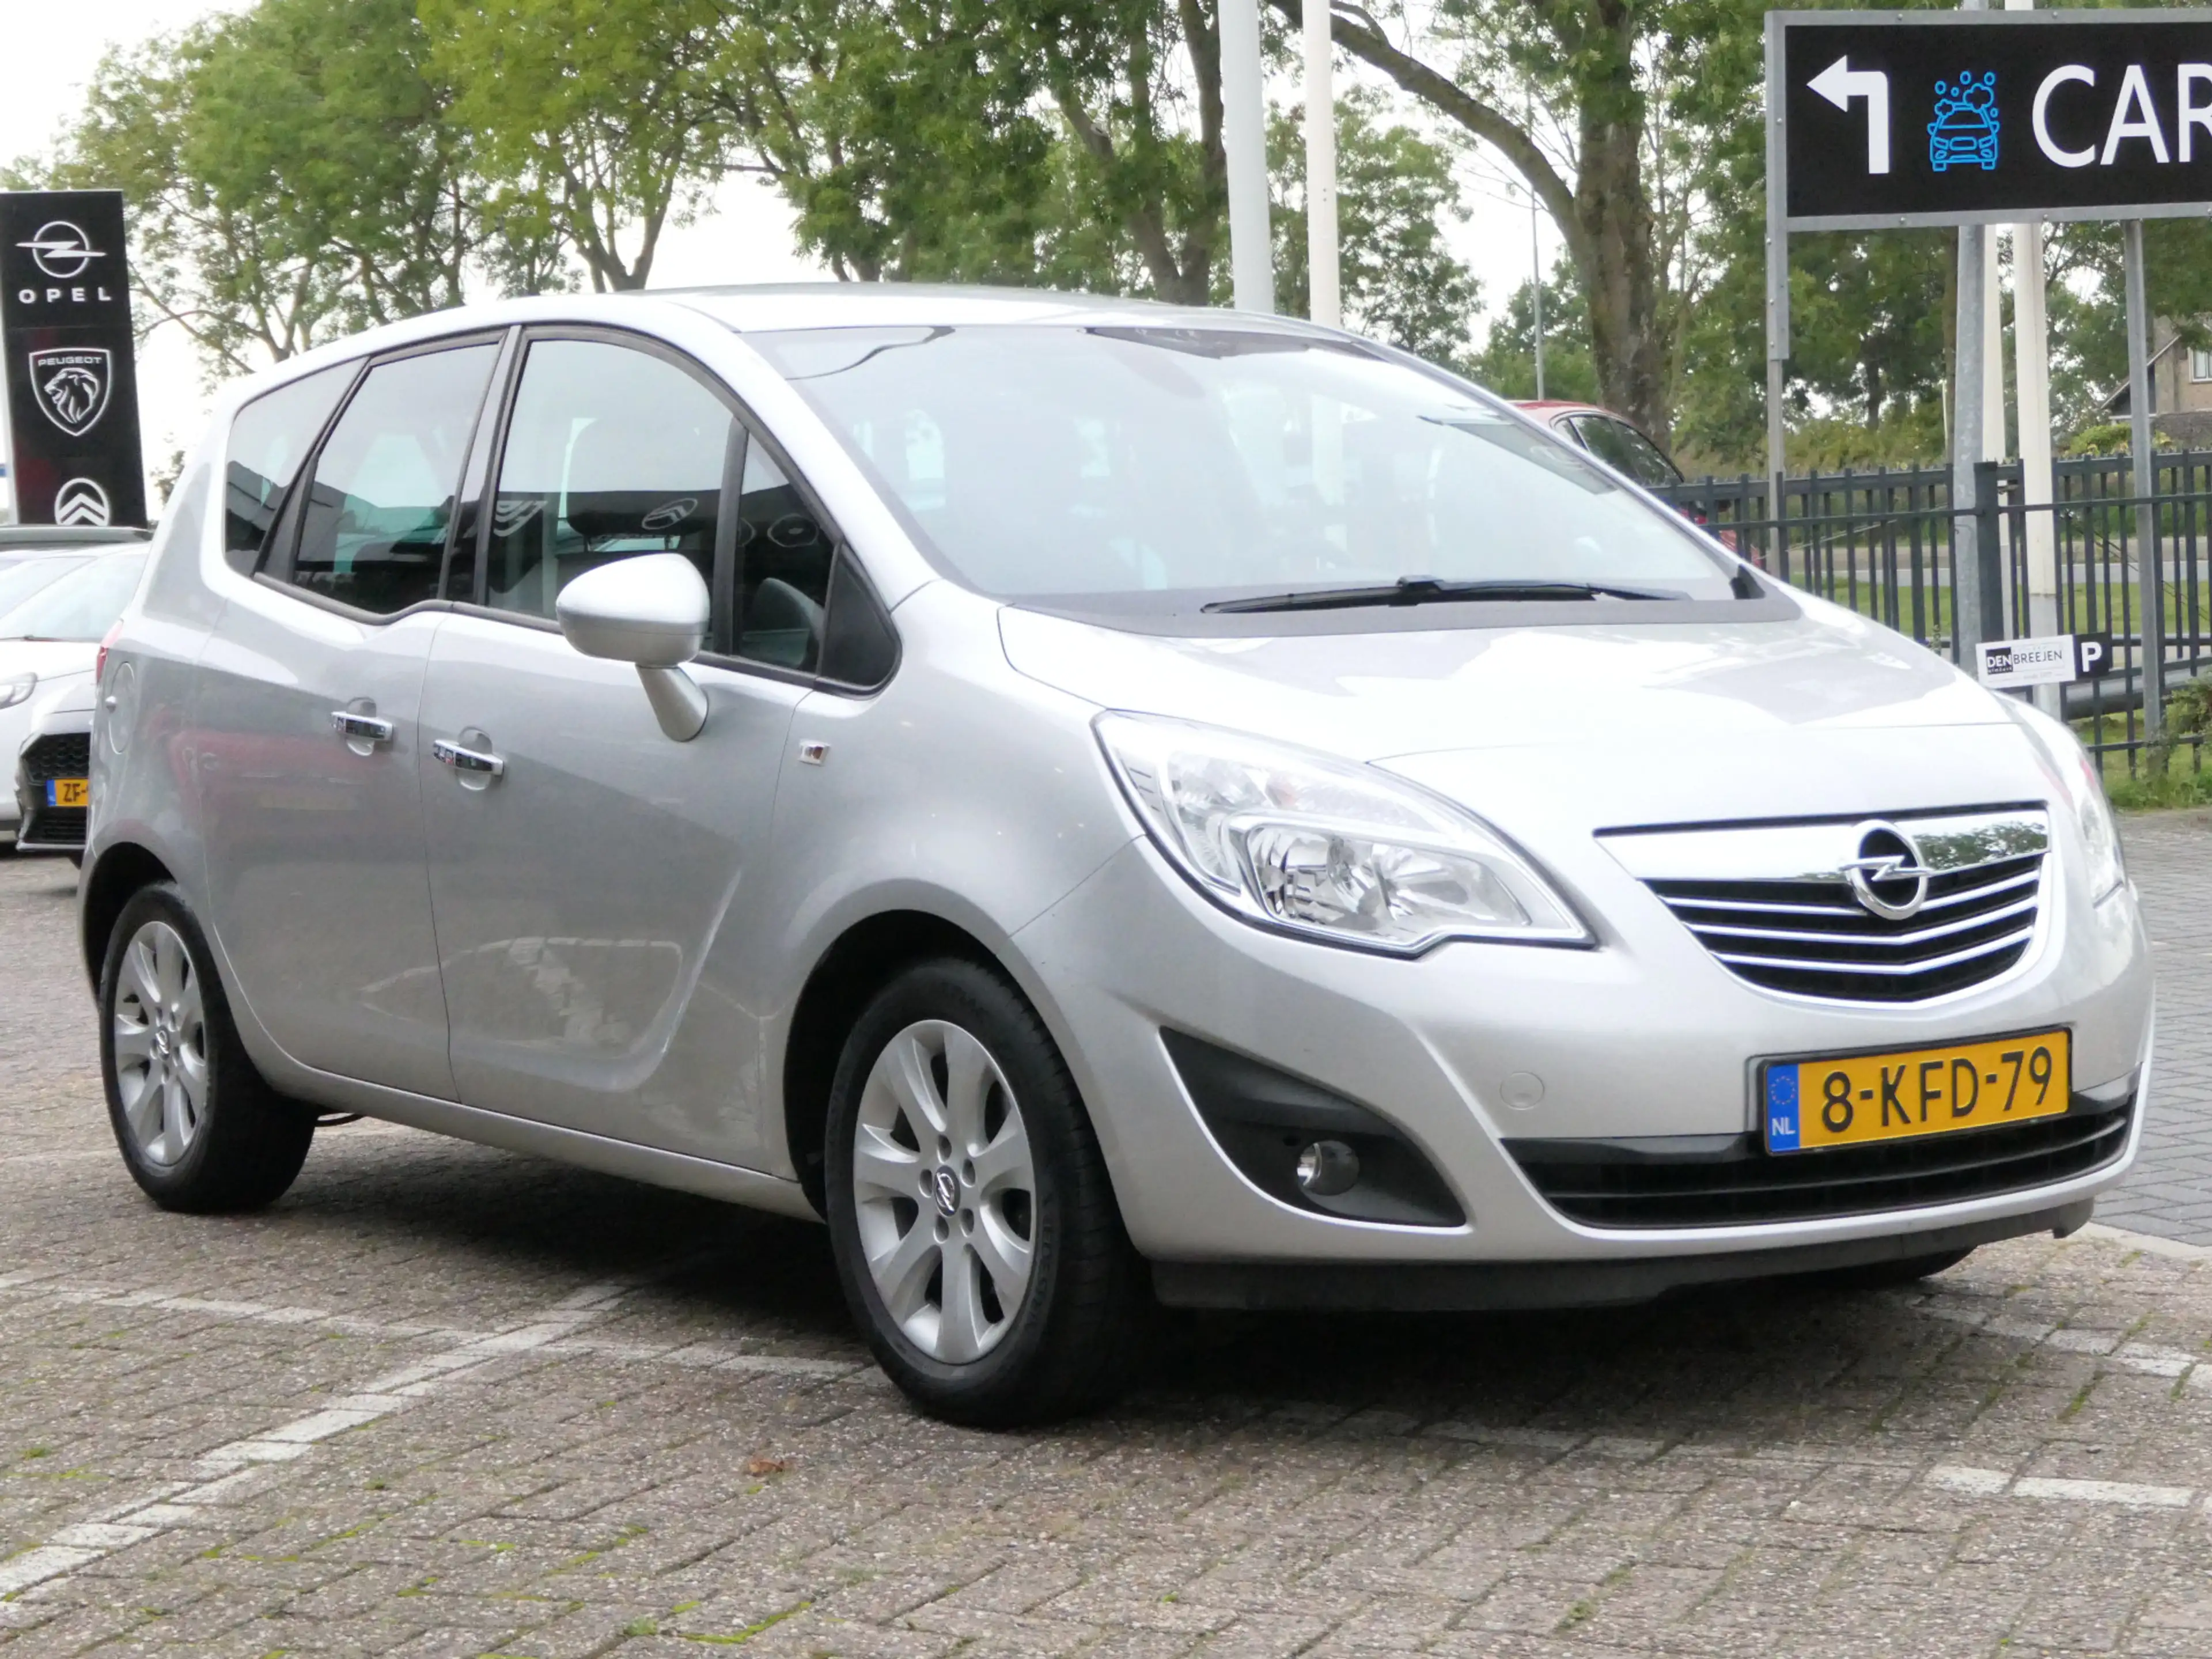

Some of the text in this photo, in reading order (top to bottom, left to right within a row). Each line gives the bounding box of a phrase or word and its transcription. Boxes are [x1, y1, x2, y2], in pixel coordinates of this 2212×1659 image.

[2032, 63, 2212, 168] CAR
[18, 287, 111, 304] OPEL
[37, 357, 102, 366] PEUGEOT
[1987, 650, 2063, 668] DEN BREEJEN
[2081, 642, 2101, 672] P
[63, 783, 89, 802] ZF-
[1821, 1046, 2052, 1133] 8-KFD-79
[1771, 1117, 1796, 1136] NL
